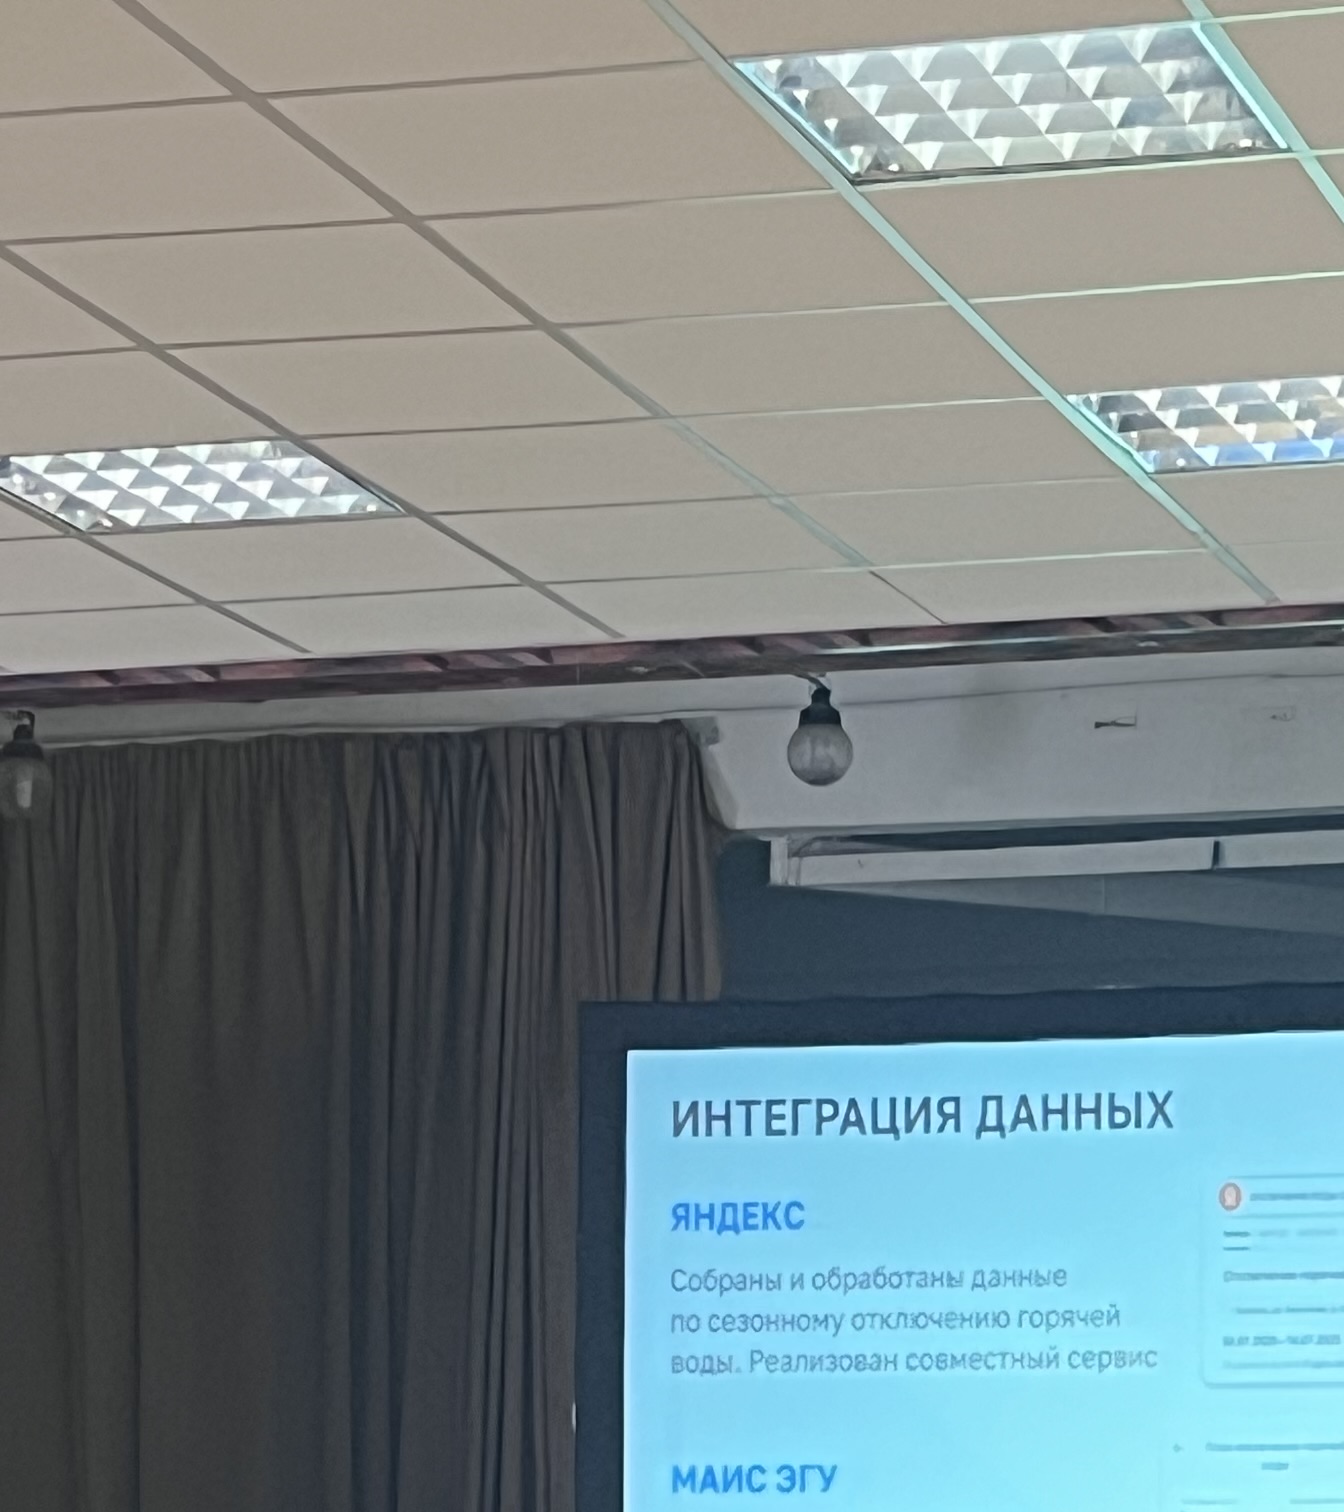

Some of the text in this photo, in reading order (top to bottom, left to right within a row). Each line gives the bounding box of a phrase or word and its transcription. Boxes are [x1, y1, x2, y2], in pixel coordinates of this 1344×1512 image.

[672, 1090, 1174, 1140] ИНТЕГРАЦИЯ ДАННЫХ
[671, 1200, 805, 1236] ЯНДЕКС
[670, 1265, 1068, 1298] Собраны и обработаны данные
[670, 1303, 1121, 1338] по сезонному отключению горячей
[748, 1348, 899, 1374] Реализован
[905, 1345, 1060, 1372] совместный
[1067, 1349, 1158, 1374] сервис
[671, 1463, 838, 1494] МАИС ЭГУ
